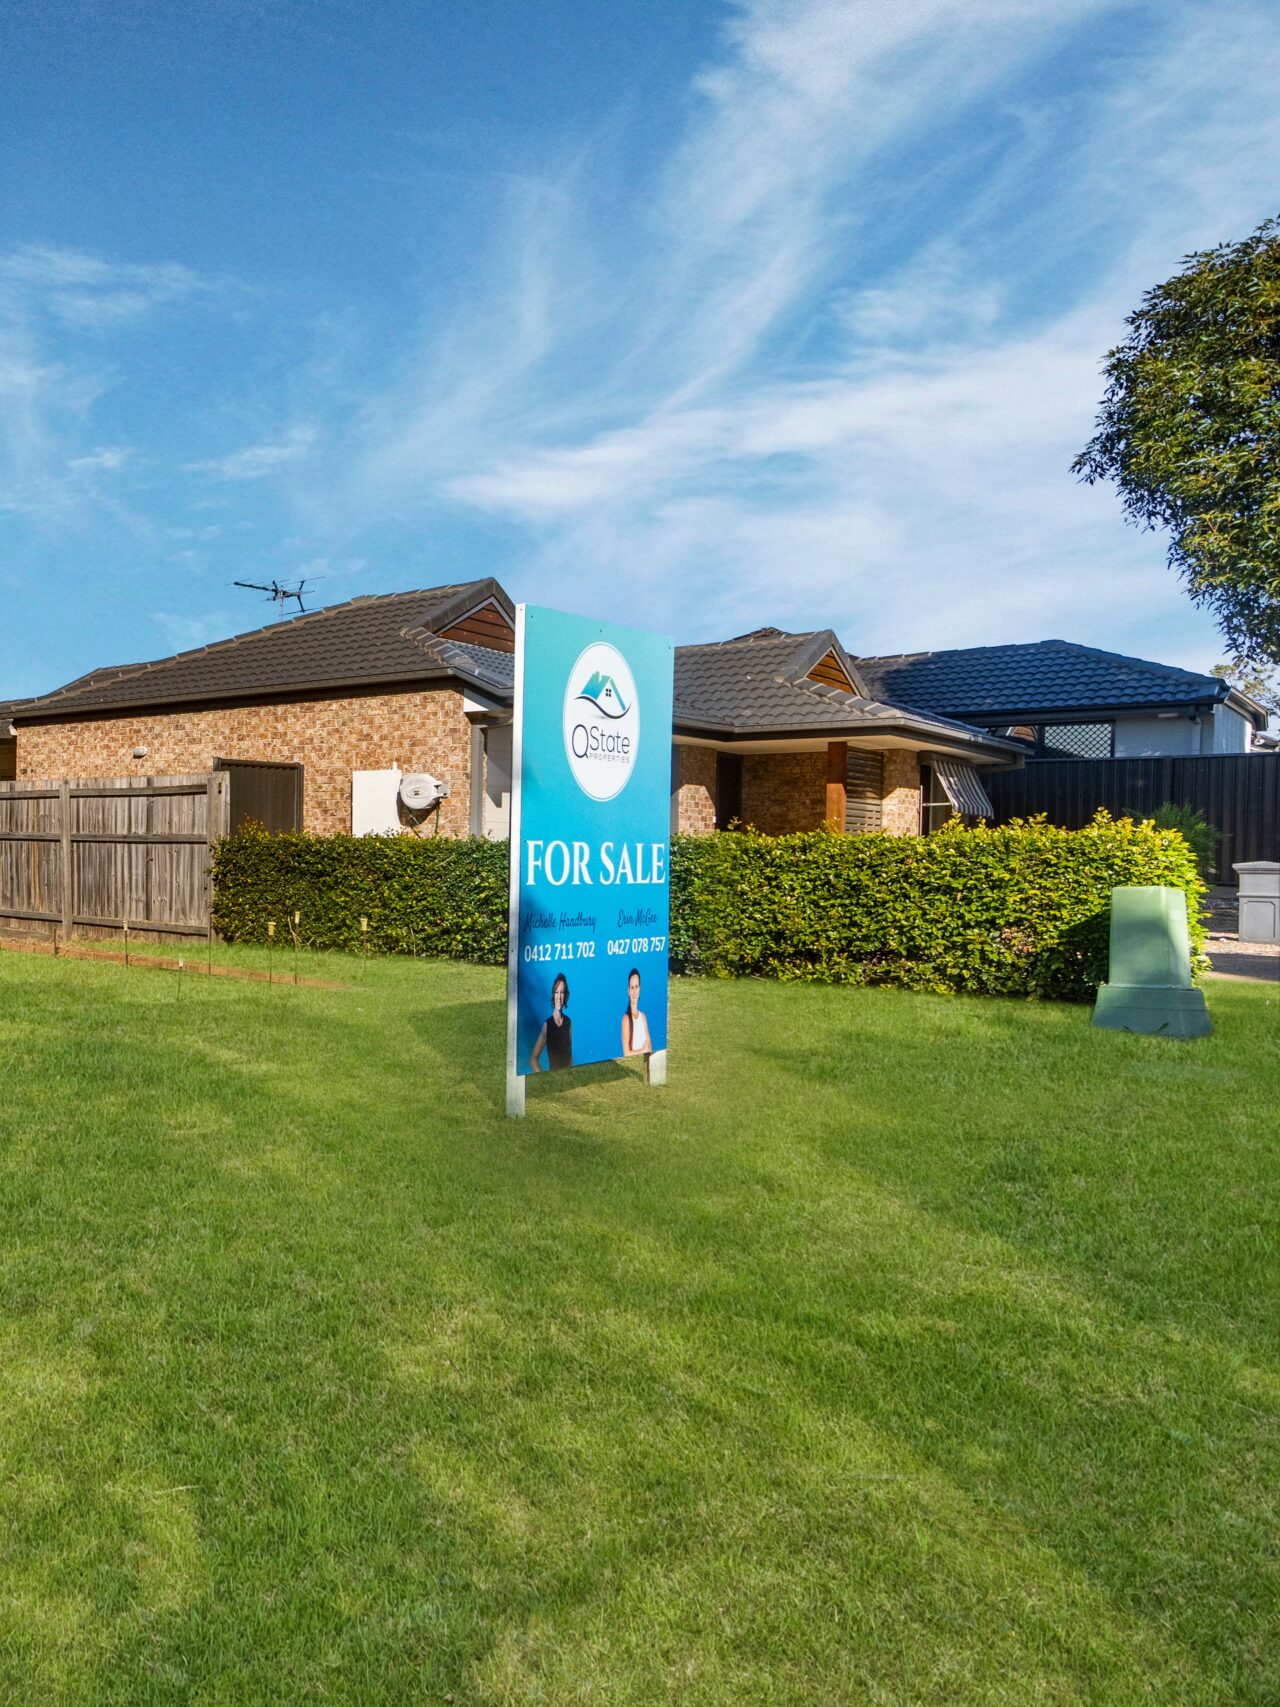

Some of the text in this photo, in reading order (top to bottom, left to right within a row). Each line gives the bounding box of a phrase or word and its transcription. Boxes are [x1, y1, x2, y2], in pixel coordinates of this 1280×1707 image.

[571, 724, 630, 759] QState
[589, 752, 630, 764] PROPERTIES
[525, 840, 666, 886] FOR SALE
[558, 911, 596, 933] Handbury
[524, 941, 595, 962] 0412 711 702
[607, 936, 666, 956] 0427 078 757
